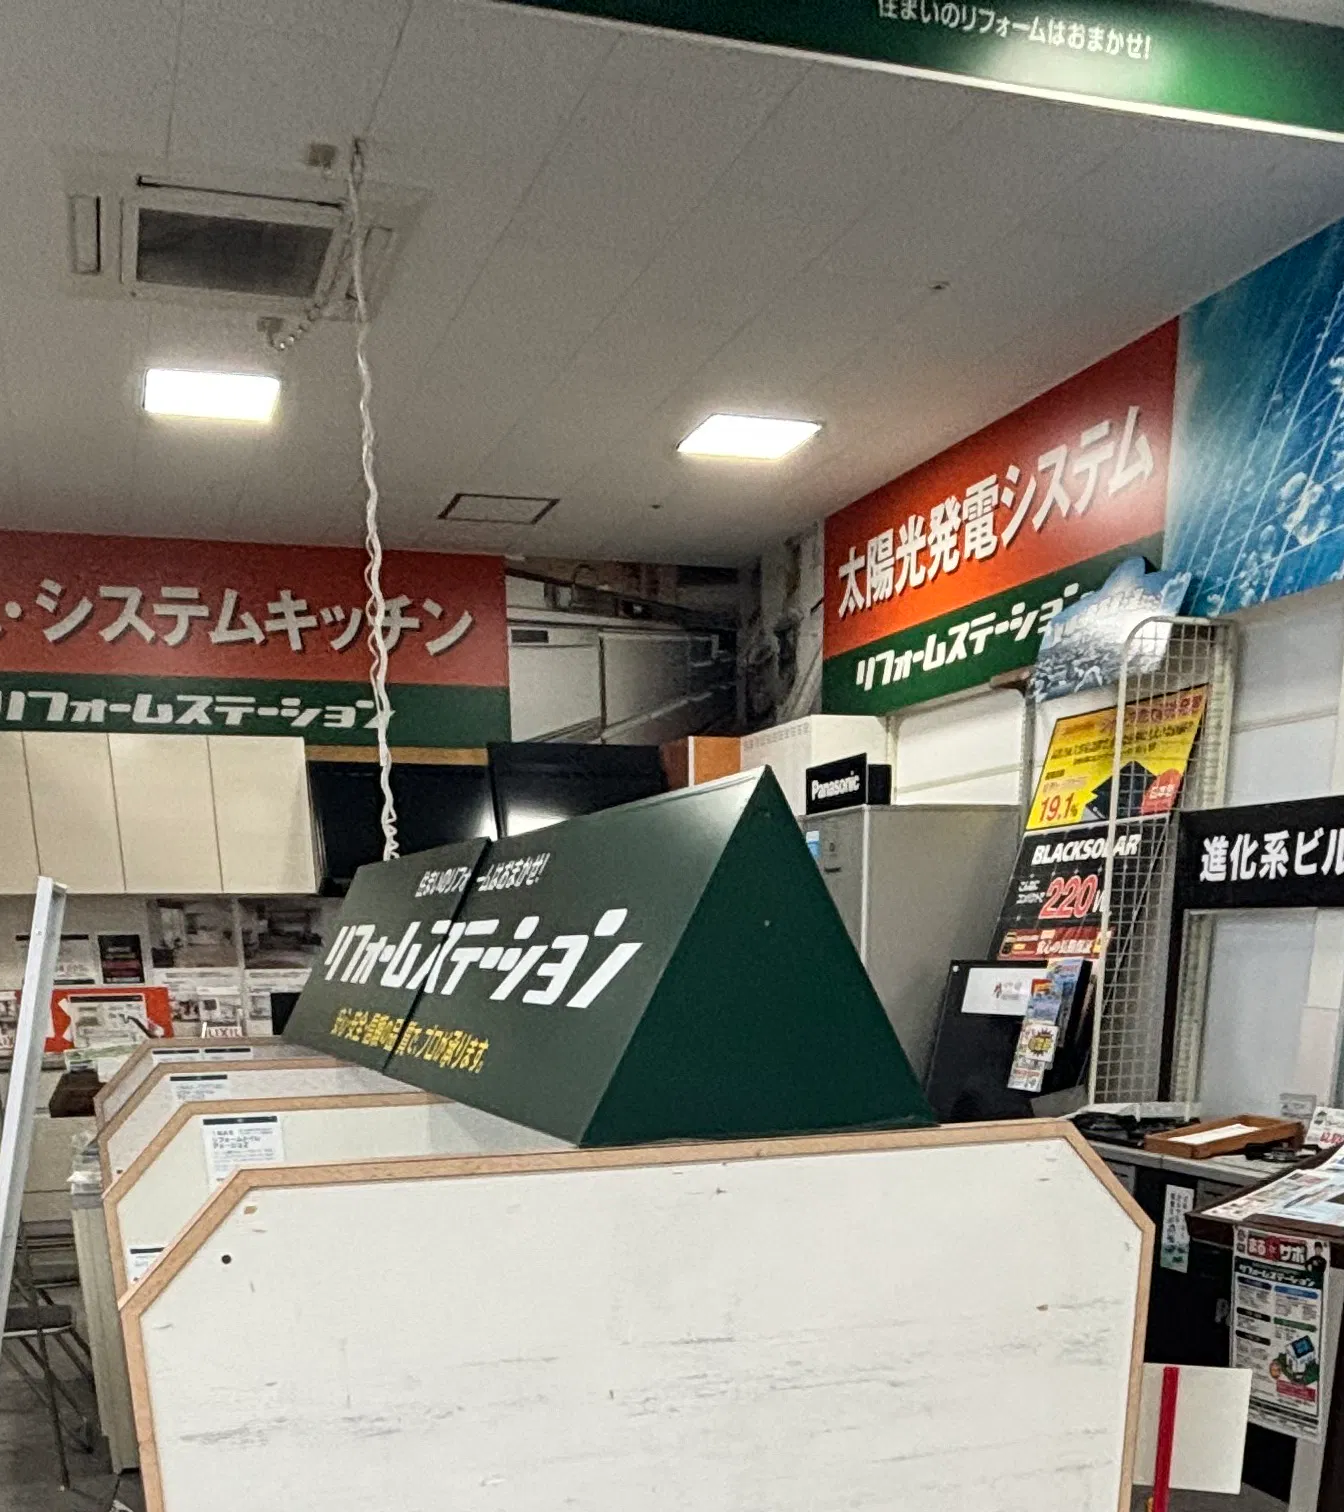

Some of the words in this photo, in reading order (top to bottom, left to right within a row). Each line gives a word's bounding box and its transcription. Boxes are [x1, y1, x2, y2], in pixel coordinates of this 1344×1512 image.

[837, 404, 1154, 618] 太陽光発電システム
[856, 582, 1080, 691] リフォームステーショ
[810, 771, 861, 802] Panasonic
[1031, 834, 1142, 866] BLACKSOAR
[323, 906, 644, 1010] リフォームステーション
